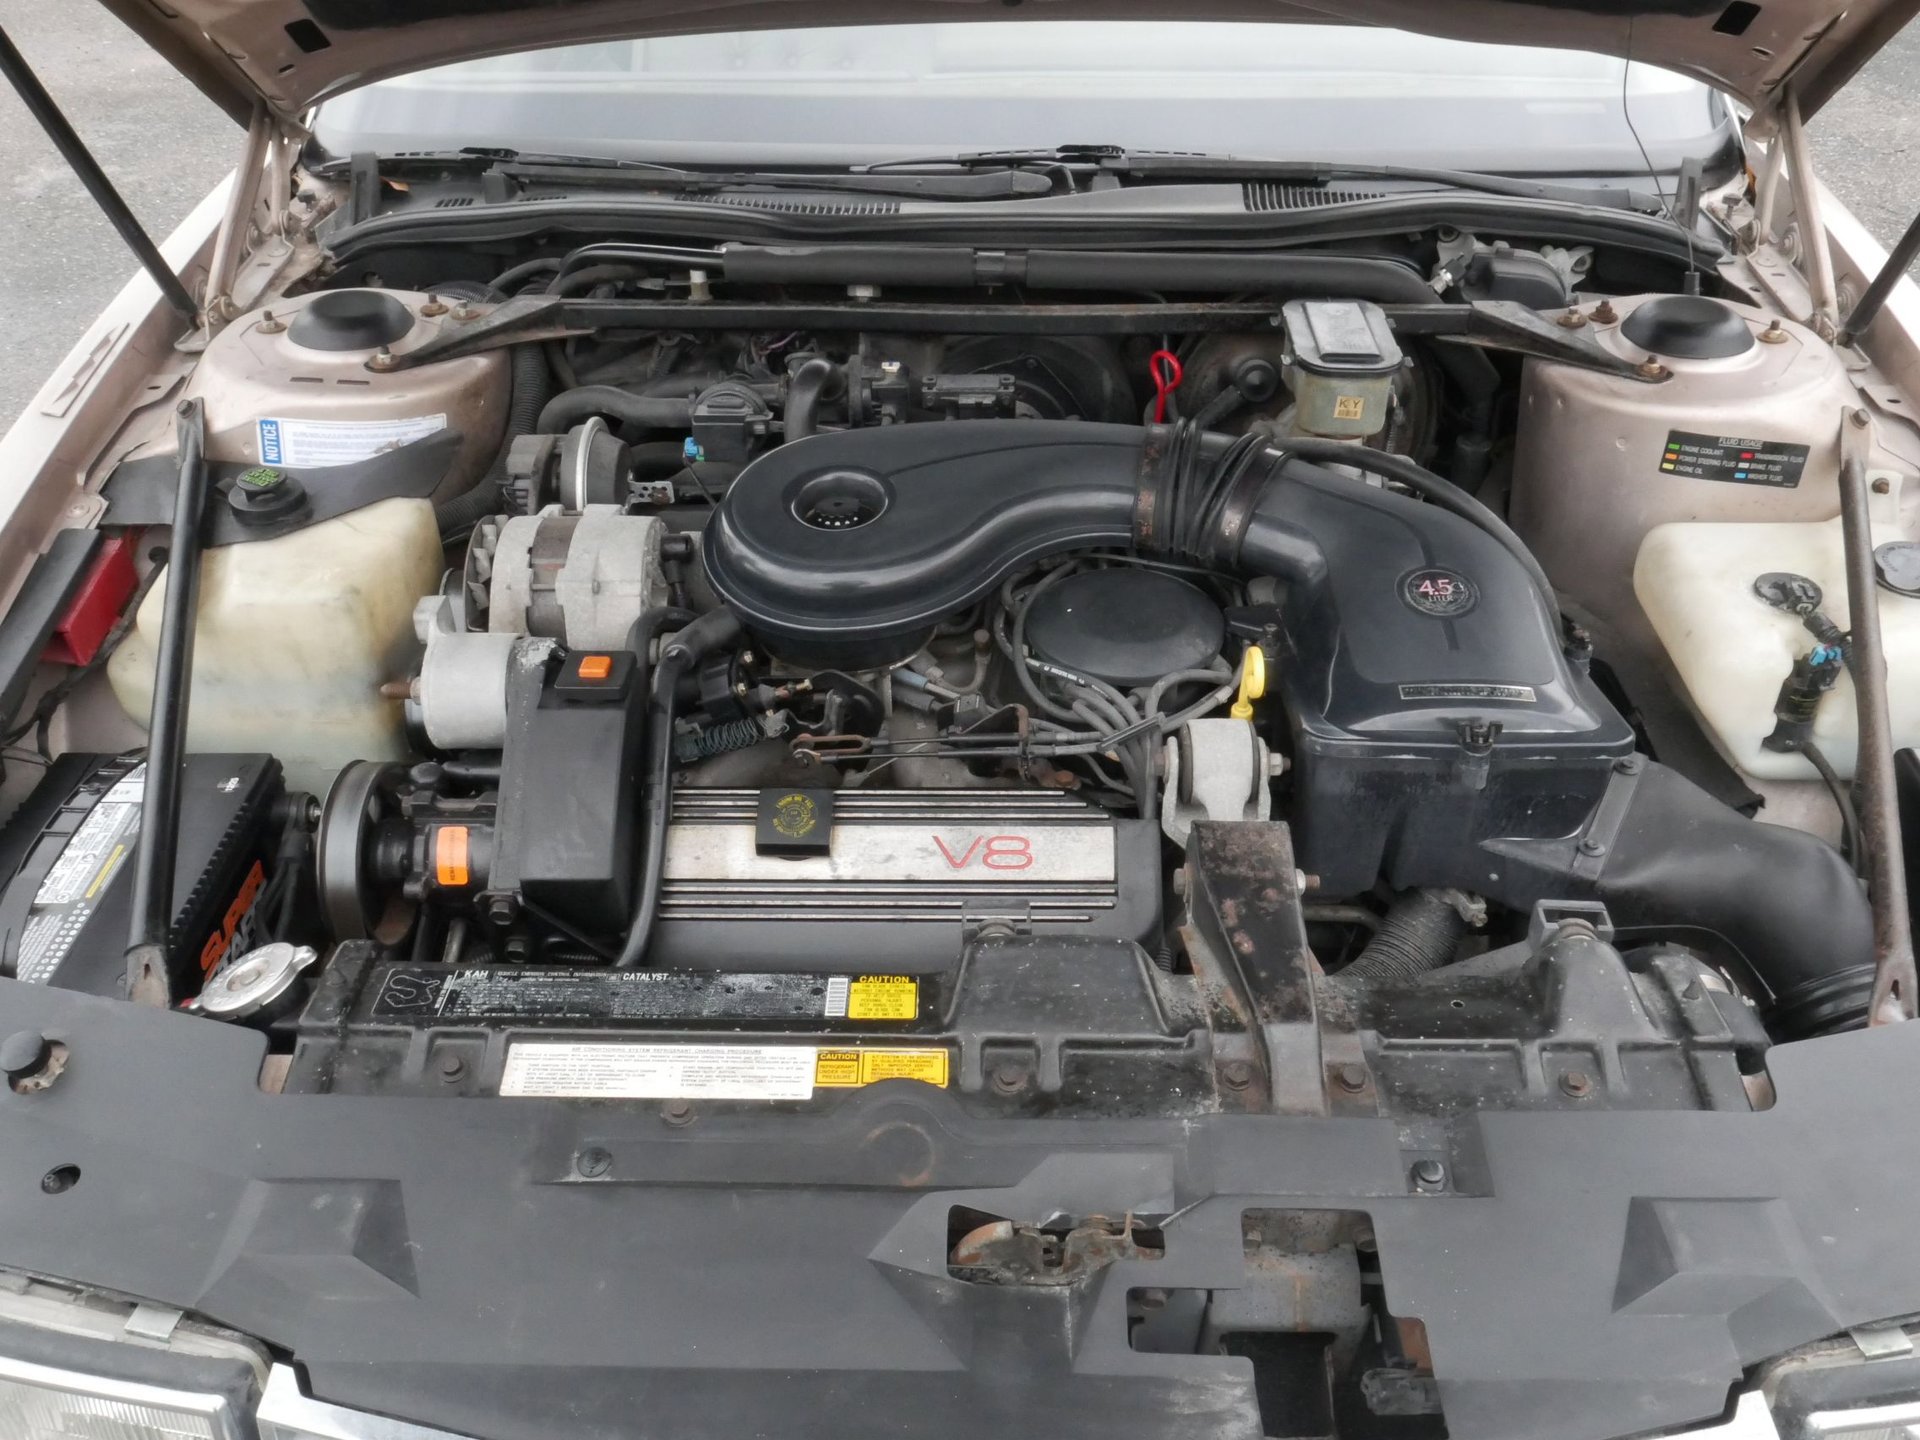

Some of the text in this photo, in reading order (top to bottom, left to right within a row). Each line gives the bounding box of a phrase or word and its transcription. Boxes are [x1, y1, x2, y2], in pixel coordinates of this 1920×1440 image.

[263, 423, 280, 461] NOTICE
[1718, 437, 1764, 448] FLUID USAGE
[1681, 445, 1724, 456] ENGINE COOLANT
[1722, 459, 1736, 467] FLUID
[1767, 464, 1782, 472] FLUID
[1675, 464, 1703, 475] ENGINE OIL
[1419, 579, 1453, 595] 4.5
[932, 835, 1033, 870] V8
[200, 859, 265, 985] SUPER
[464, 970, 489, 978] KAH
[622, 973, 669, 981] CATALYST
[859, 975, 910, 983] CAUTION
